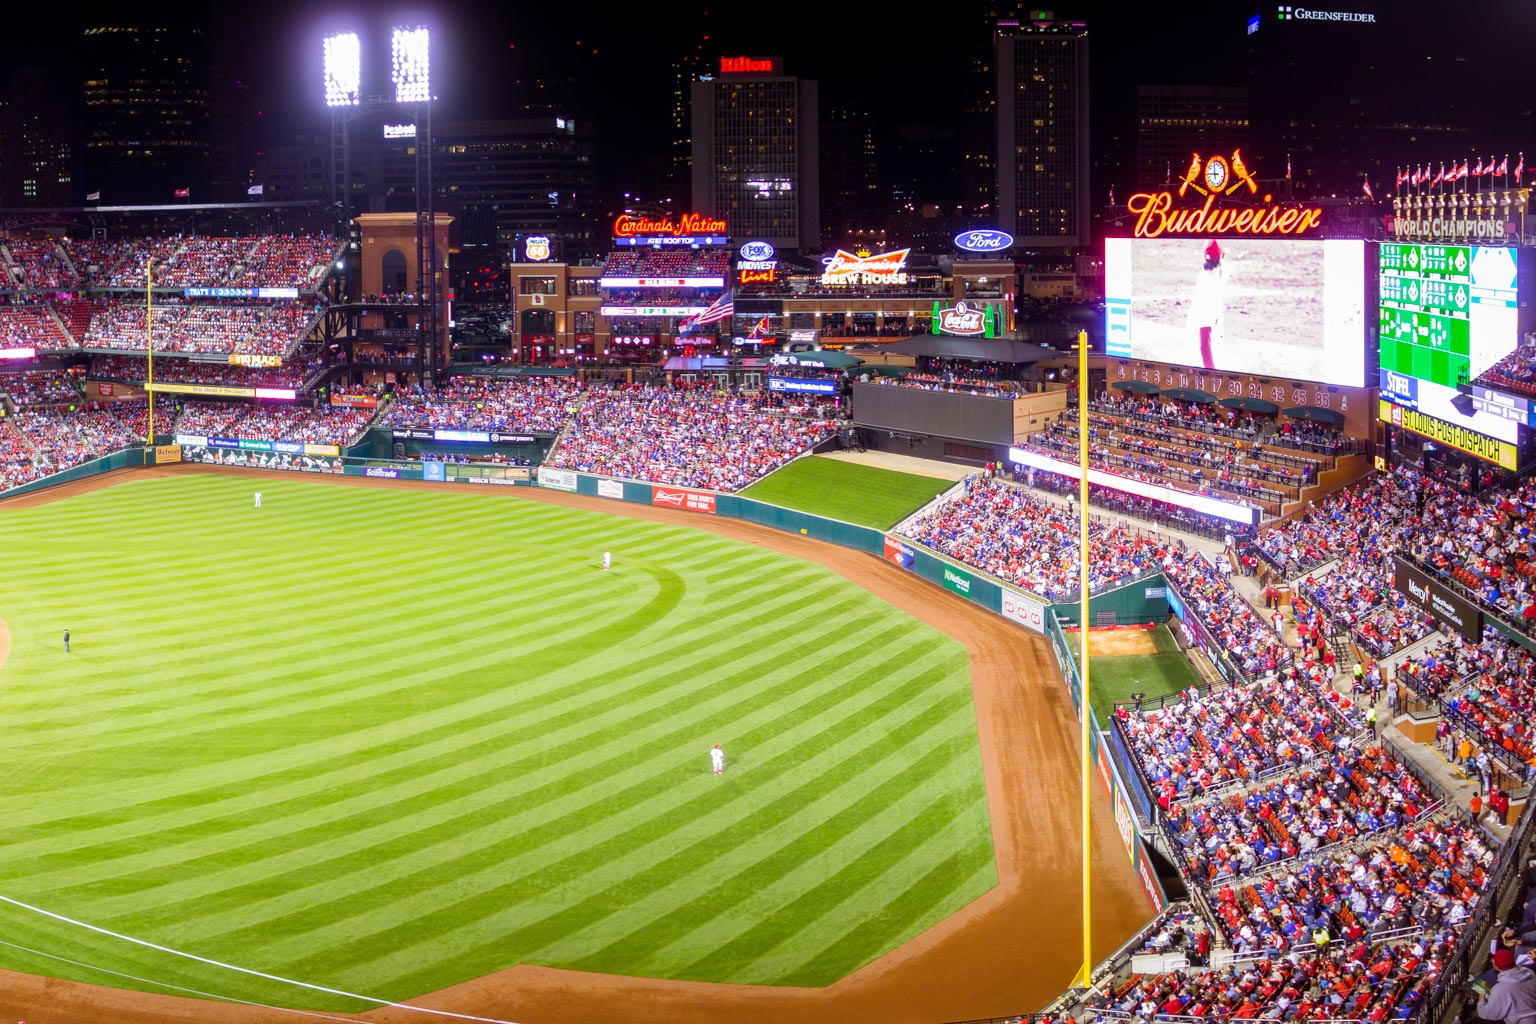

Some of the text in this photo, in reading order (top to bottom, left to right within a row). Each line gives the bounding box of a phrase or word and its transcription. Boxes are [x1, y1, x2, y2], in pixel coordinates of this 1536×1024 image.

[1294, 8, 1376, 23] GREENSFELDER
[721, 56, 772, 72] Hilton
[383, 124, 416, 135] Peabod
[1128, 192, 1322, 238] Budweiser
[615, 212, 726, 236] Cardinals Nation
[1394, 217, 1504, 237] WORLD CHAMPIONS
[966, 232, 1001, 248] Ford
[530, 246, 547, 257] 66
[748, 246, 767, 256] FOX
[737, 261, 777, 270] MIDWEST
[822, 257, 907, 272] Budweiser
[740, 270, 776, 285] Live!
[822, 273, 907, 285] BREW HOUSE
[251, 355, 276, 366] MAC
[772, 380, 783, 389] BJC
[1178, 373, 1189, 388] 10
[1195, 376, 1205, 391] 14
[1211, 377, 1222, 392] 17
[1228, 381, 1242, 396] 20
[1249, 383, 1263, 399] 24
[1270, 386, 1284, 402] 42
[1292, 389, 1306, 405] 45
[1315, 392, 1330, 408] 85
[1404, 408, 1500, 462] ST. LOUIS POST-DISPATCH
[366, 467, 397, 478] Scottrade
[687, 493, 715, 504] THIS BUD'S
[950, 572, 970, 588] National
[1408, 579, 1425, 603] Mercy
